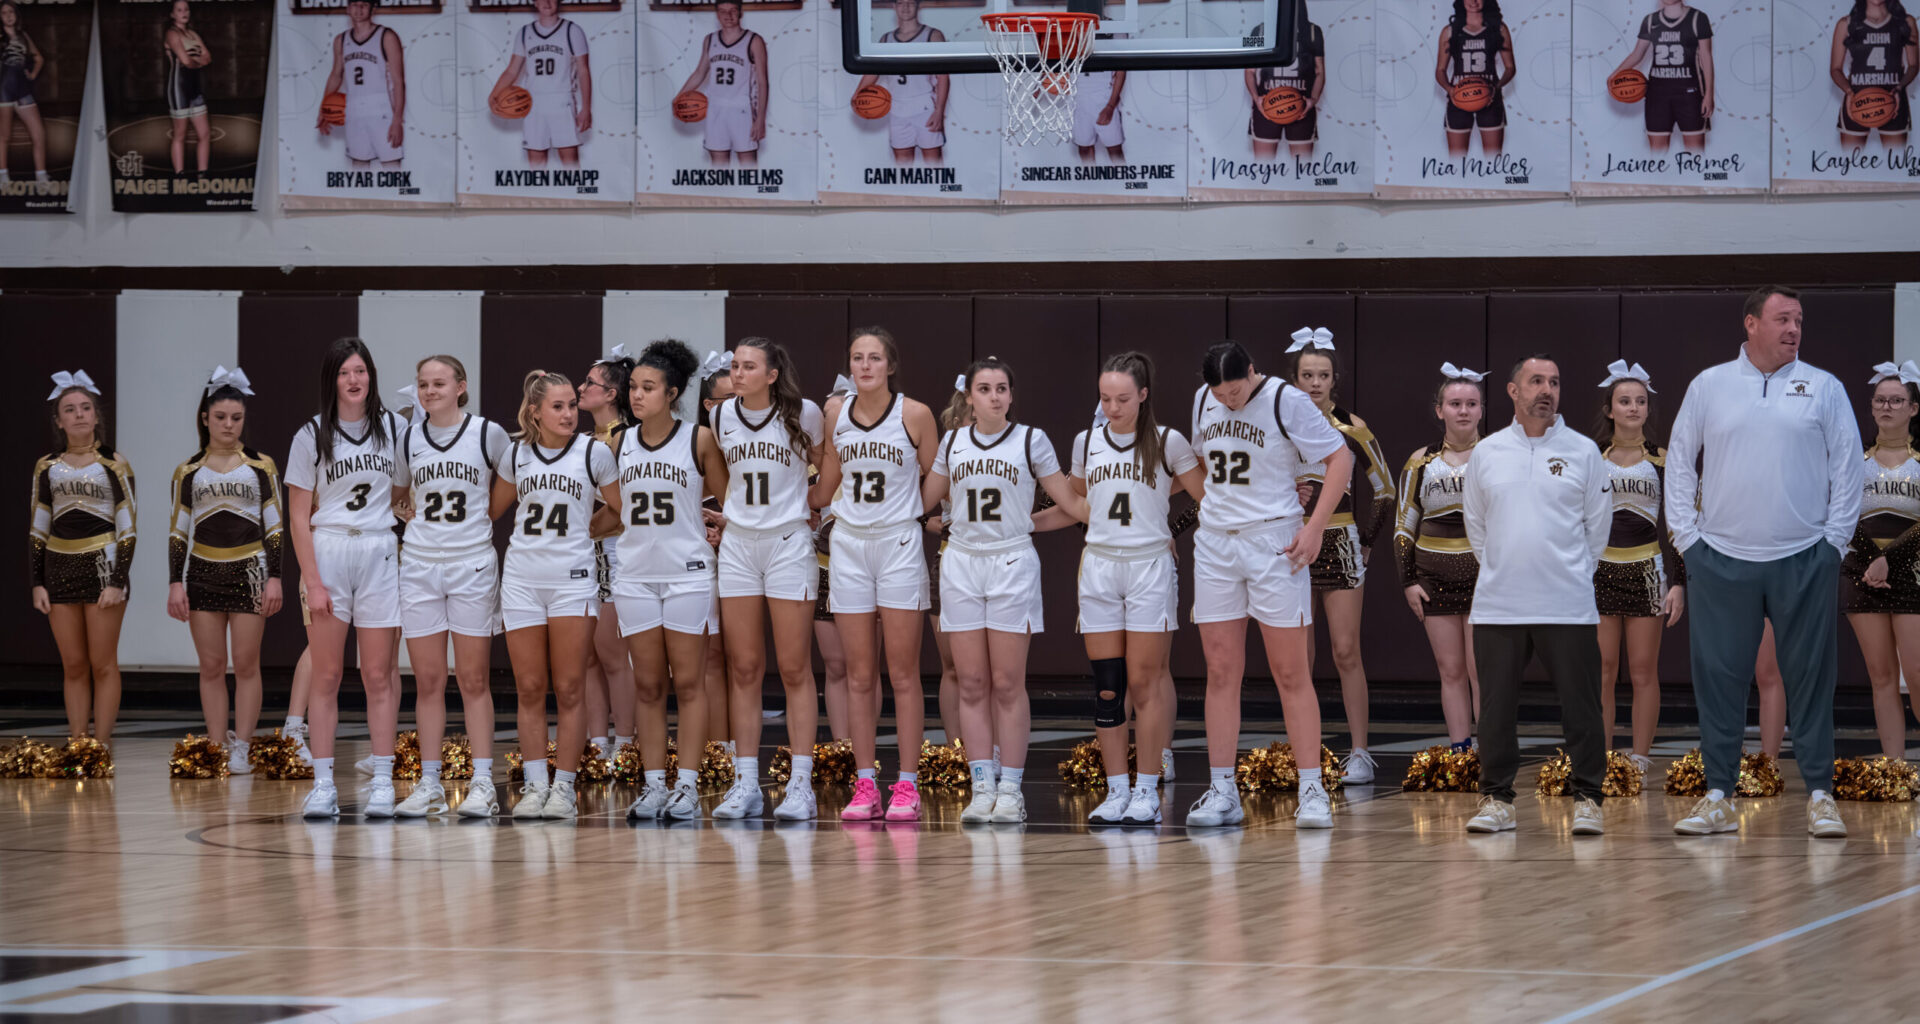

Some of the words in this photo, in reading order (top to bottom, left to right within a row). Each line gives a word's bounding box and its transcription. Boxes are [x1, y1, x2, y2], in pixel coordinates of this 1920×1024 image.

[1462, 39, 1486, 50] JOHN
[1658, 31, 1681, 42] JOHN
[1863, 32, 1891, 44] JOHN
[535, 58, 555, 75] 20
[1462, 51, 1486, 73] 13
[1655, 44, 1684, 65] 23
[1866, 46, 1886, 70] 4
[354, 66, 364, 85] 2
[716, 67, 735, 85] 23
[1650, 67, 1692, 78] MARSHALL
[1851, 72, 1899, 85] MARSHALL
[1021, 166, 1071, 181] SINCEAR
[1074, 164, 1175, 180] SAUNDERS-PAIGE
[1211, 157, 1289, 184] Masyn
[1295, 152, 1359, 180] Inclan
[1422, 156, 1457, 179] Nia
[1462, 153, 1533, 179] Miller
[1602, 153, 1670, 177] Lainee
[1675, 151, 1745, 175] Farmer
[1811, 146, 1882, 176] Kaylee
[1888, 145, 1920, 170] Wh
[114, 179, 169, 195] PAIGE
[327, 171, 373, 188] BRYAR
[377, 171, 411, 187] CORK
[495, 170, 550, 186] KAYDEN
[553, 170, 599, 186] KNAPP
[672, 169, 735, 186] JACKSON
[738, 169, 783, 186] HELMS
[864, 168, 897, 184] CAIN
[900, 168, 955, 184] MARTIN
[940, 184, 963, 192] SENIOR
[1314, 178, 1338, 186] SENIOR
[1505, 176, 1529, 184] SENIOR
[1704, 172, 1728, 181] SENIOR
[1203, 420, 1266, 448] MONARCHS
[725, 441, 791, 467] MONARCHS
[326, 453, 393, 486] MONARCHS
[413, 461, 480, 489] MONARCHS
[620, 461, 688, 489] MONARCHS
[952, 458, 1020, 487] MONARCHS
[1208, 450, 1251, 485] 32
[346, 483, 372, 512] 3
[517, 473, 583, 501] MONARCHS
[743, 471, 770, 506] 11
[851, 470, 886, 504] 13
[424, 491, 467, 523] 23
[630, 491, 675, 526] 25
[966, 487, 1002, 522] 12
[1108, 492, 1132, 527] 4
[523, 503, 568, 537] 24
